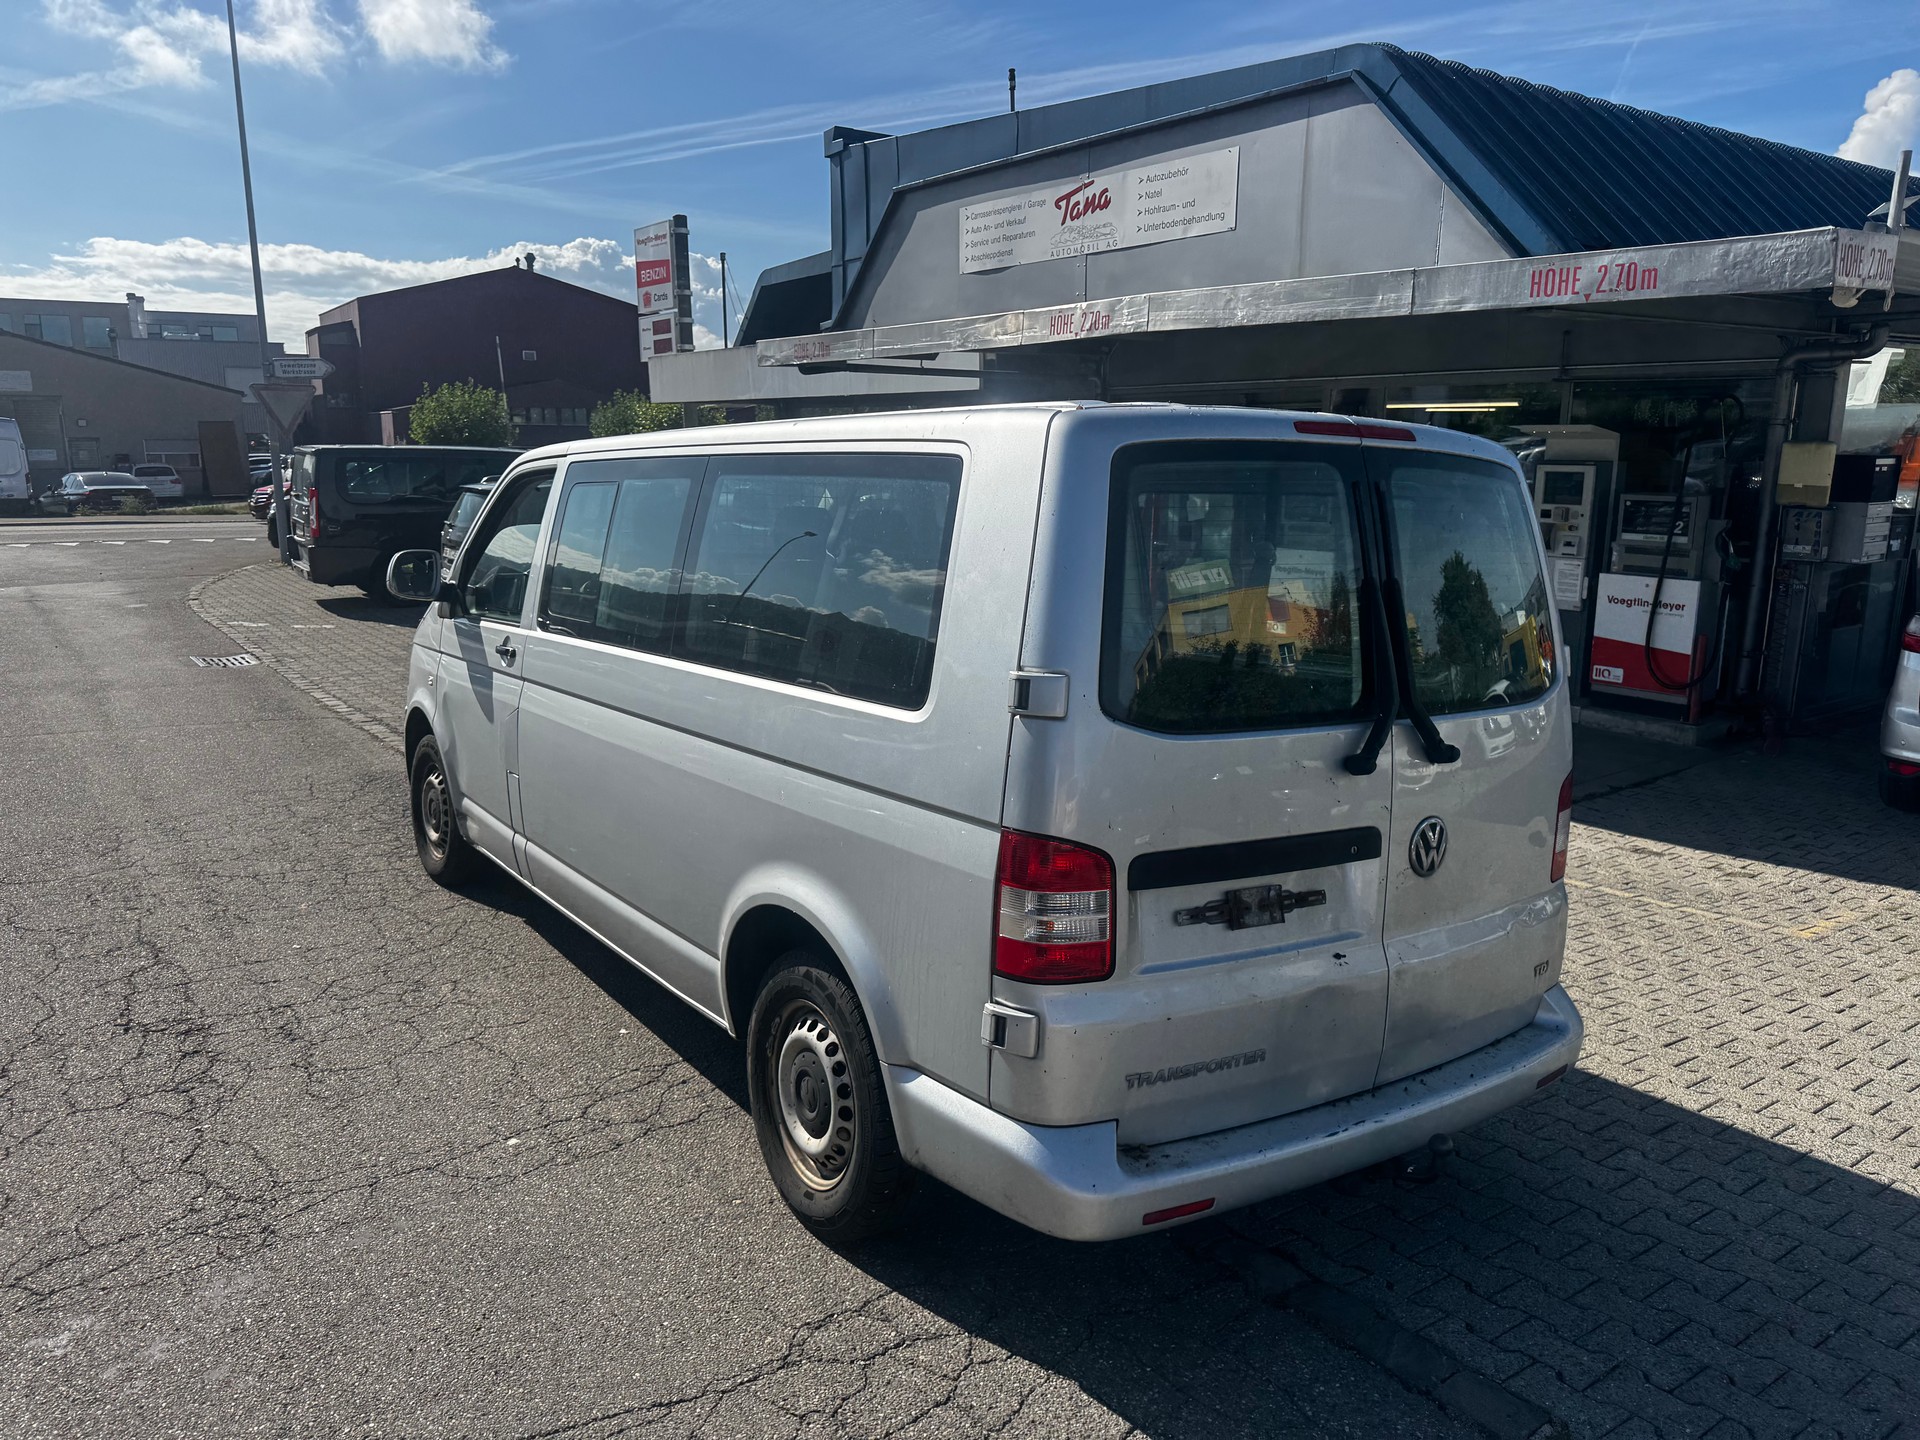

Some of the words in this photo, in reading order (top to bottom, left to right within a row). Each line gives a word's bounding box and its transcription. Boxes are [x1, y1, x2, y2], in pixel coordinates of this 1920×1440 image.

[1145, 167, 1189, 184] Autozubehör
[1054, 179, 1112, 227] Tana
[1144, 188, 1163, 200] Natel
[970, 202, 1023, 220] Carrosseriespenglerei
[1027, 198, 1047, 208] Garage
[1144, 203, 1180, 216] Hohlraum-
[1182, 198, 1196, 208] und
[970, 226, 982, 235] Auto
[983, 224, 993, 232] An-
[994, 220, 1005, 230] und
[1005, 215, 1027, 227] Verkauf
[1143, 211, 1226, 233] Unterbodenbehandlung
[970, 237, 990, 249] Service
[990, 236, 1001, 245] und
[1002, 230, 1036, 243] Reparaturen
[1050, 242, 1100, 258] AUTOMOBIL
[1105, 239, 1118, 248] AG
[970, 248, 1014, 263] Abschleppdienst
[1838, 236, 1865, 278] HÖHE
[640, 266, 667, 283] BENZIN
[1529, 262, 1582, 298] HÖHE
[653, 292, 668, 302] Cards
[1049, 310, 1075, 336] HÖHE
[1673, 521, 1684, 534] 2
[1533, 960, 1550, 977] TDI
[1125, 1048, 1267, 1090] TRANSPORTER
